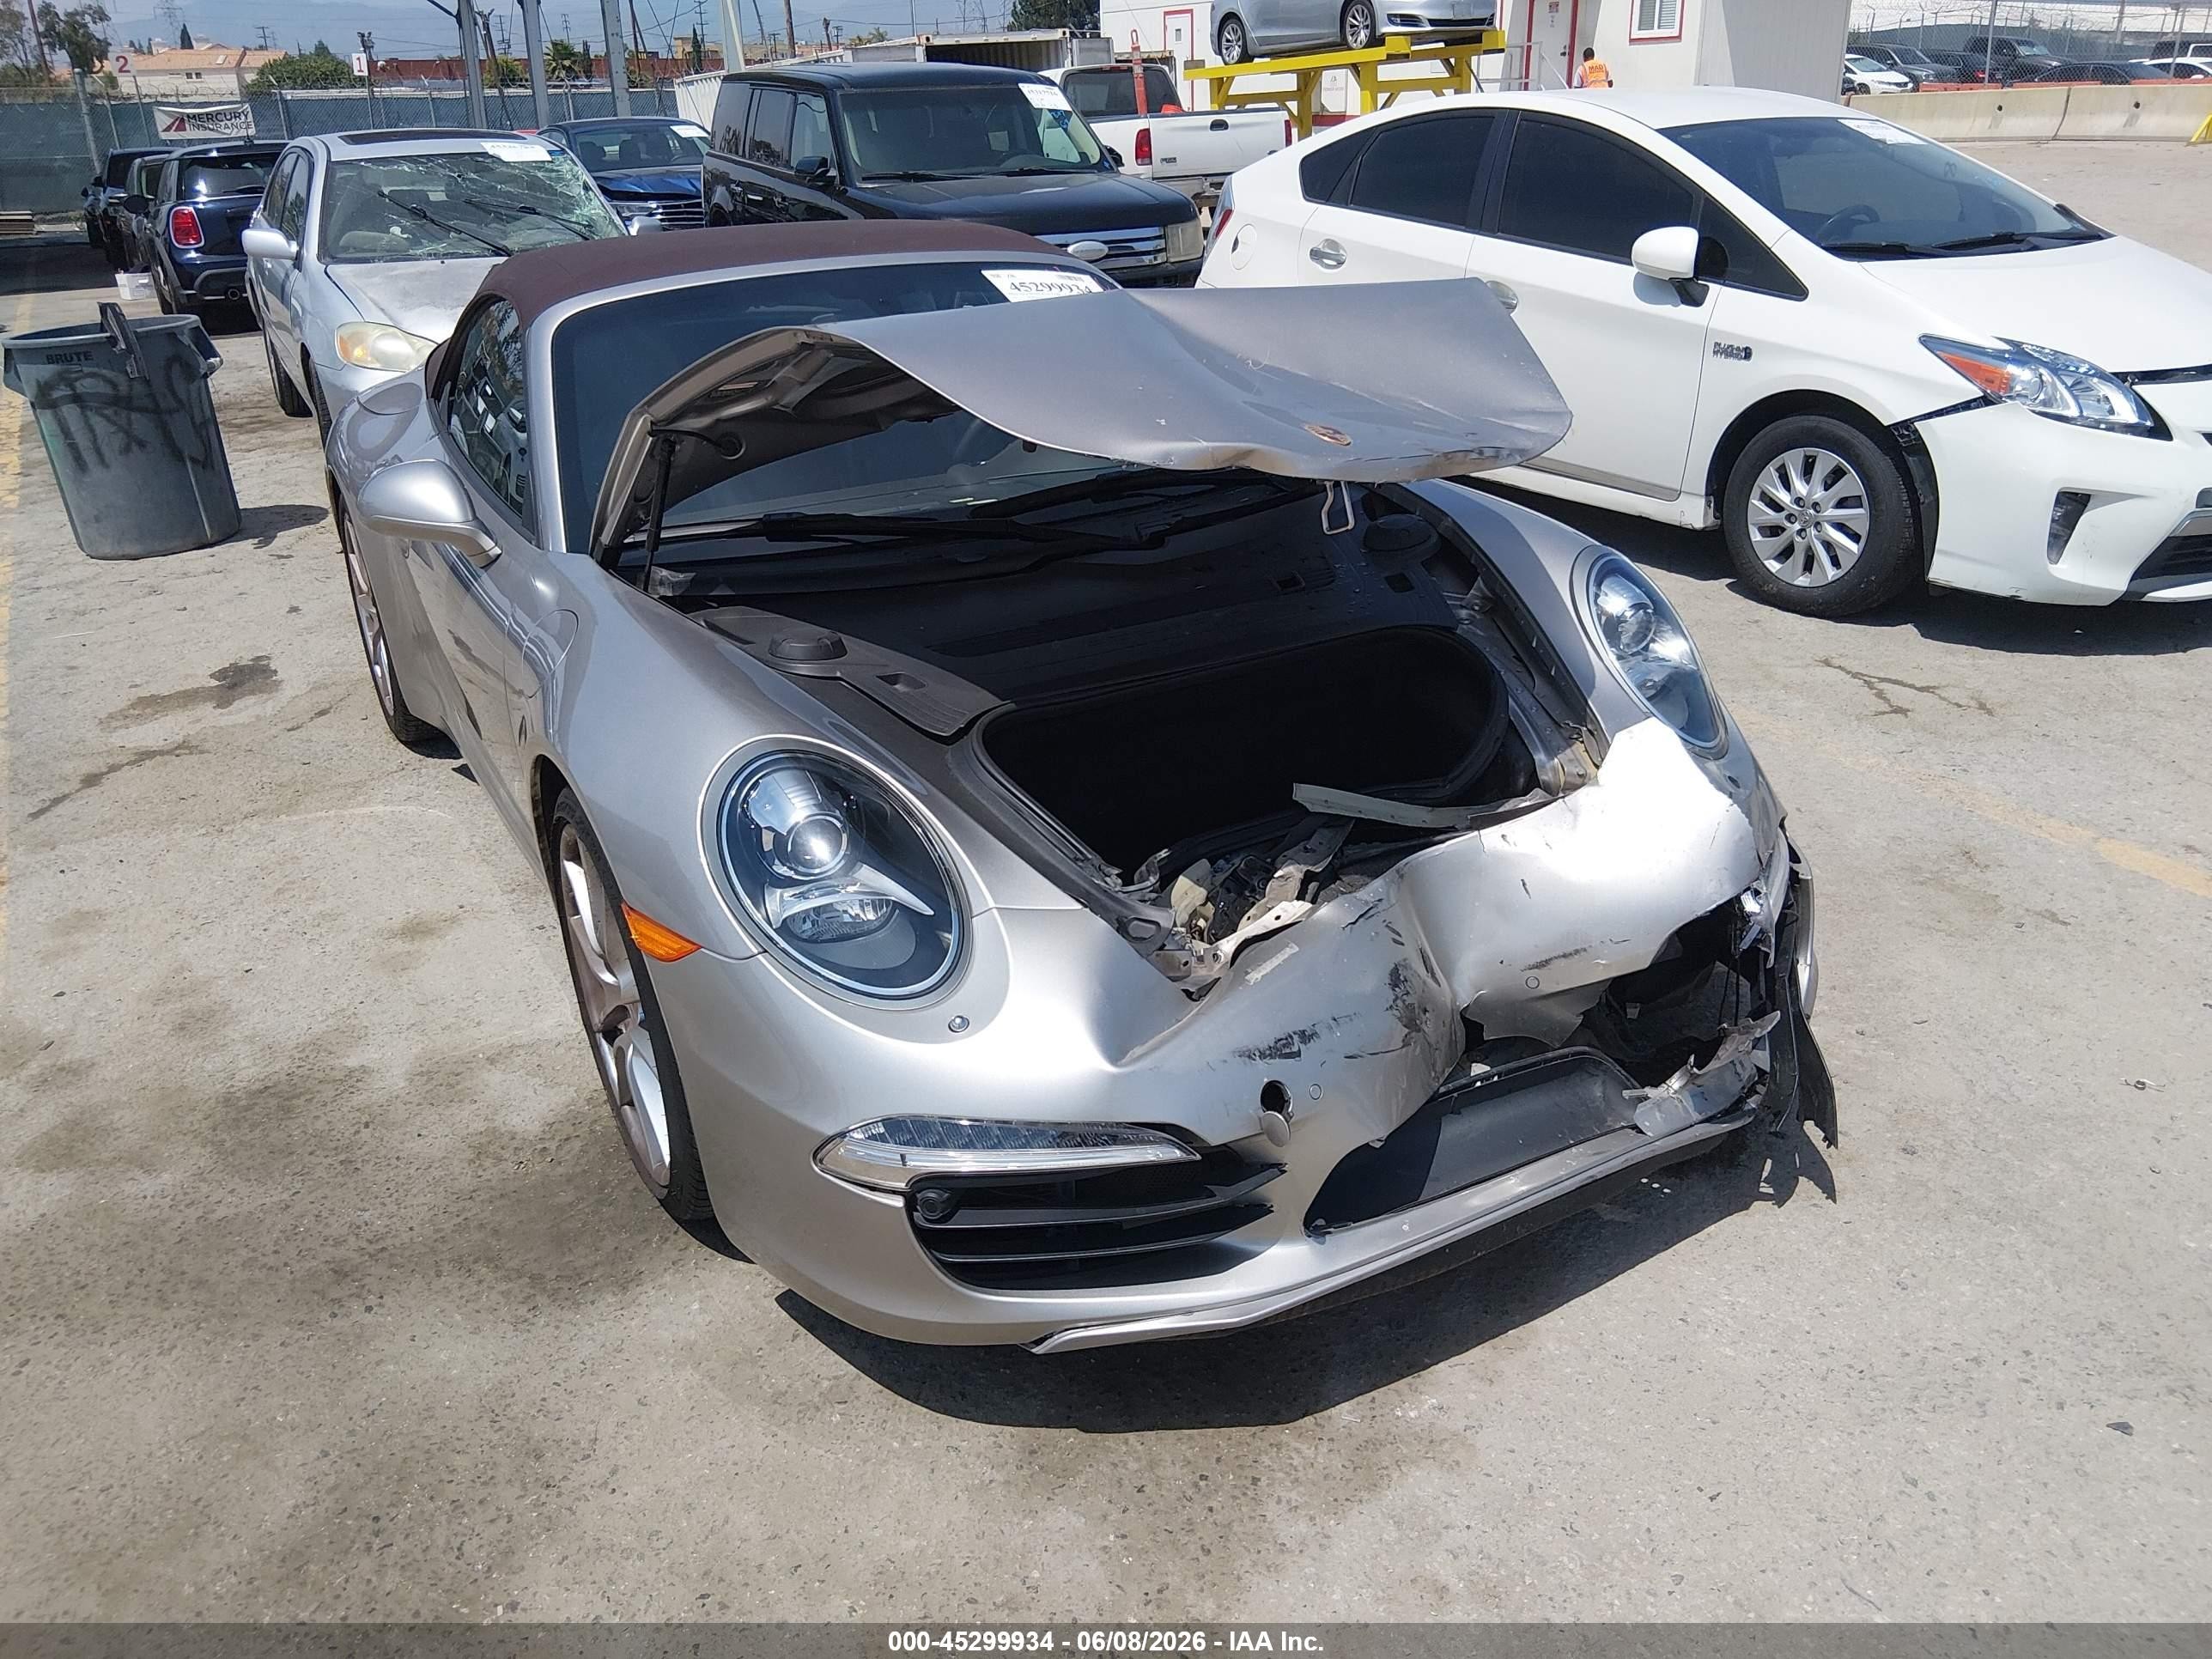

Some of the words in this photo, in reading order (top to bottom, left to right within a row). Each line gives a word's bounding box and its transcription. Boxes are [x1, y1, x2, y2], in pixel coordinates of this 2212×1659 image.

[115, 55, 131, 74] 2
[356, 56, 364, 73] 1
[186, 111, 250, 125] MERCURY
[189, 120, 254, 132] INSURANCE
[46, 350, 94, 364] BRUTE
